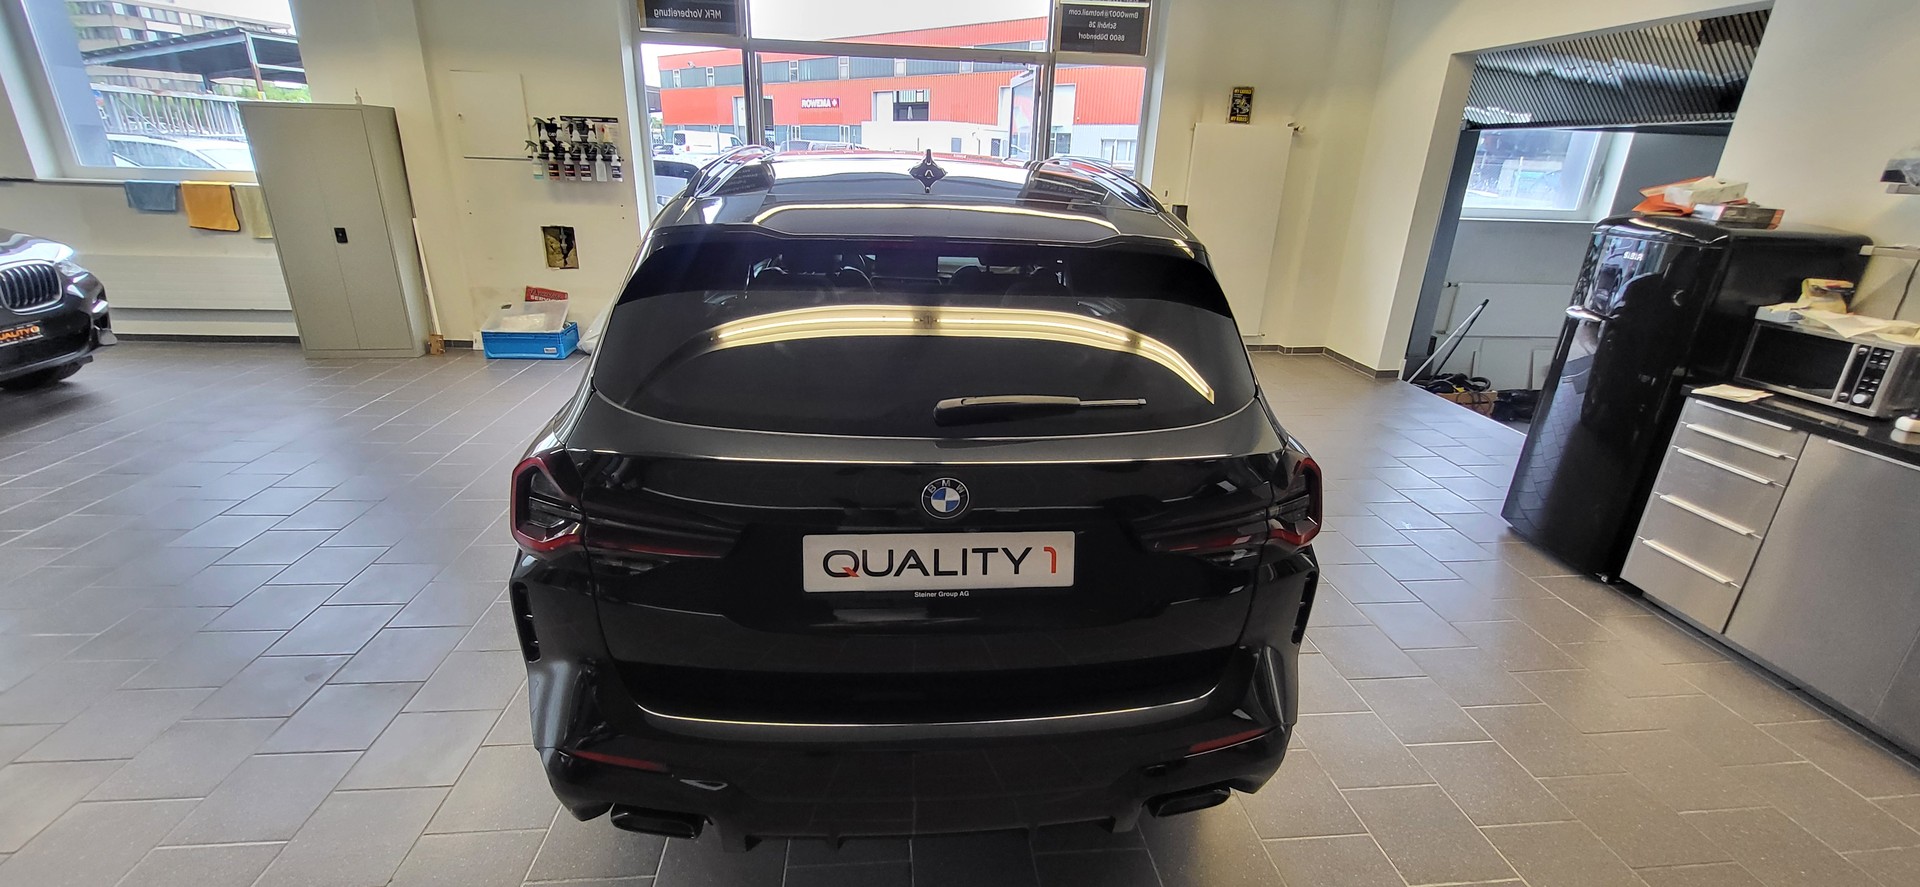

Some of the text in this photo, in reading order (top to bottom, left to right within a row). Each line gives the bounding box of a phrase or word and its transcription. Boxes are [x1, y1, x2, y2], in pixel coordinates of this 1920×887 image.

[822, 546, 1057, 578] QUALITY 1
[938, 590, 959, 598] Group
